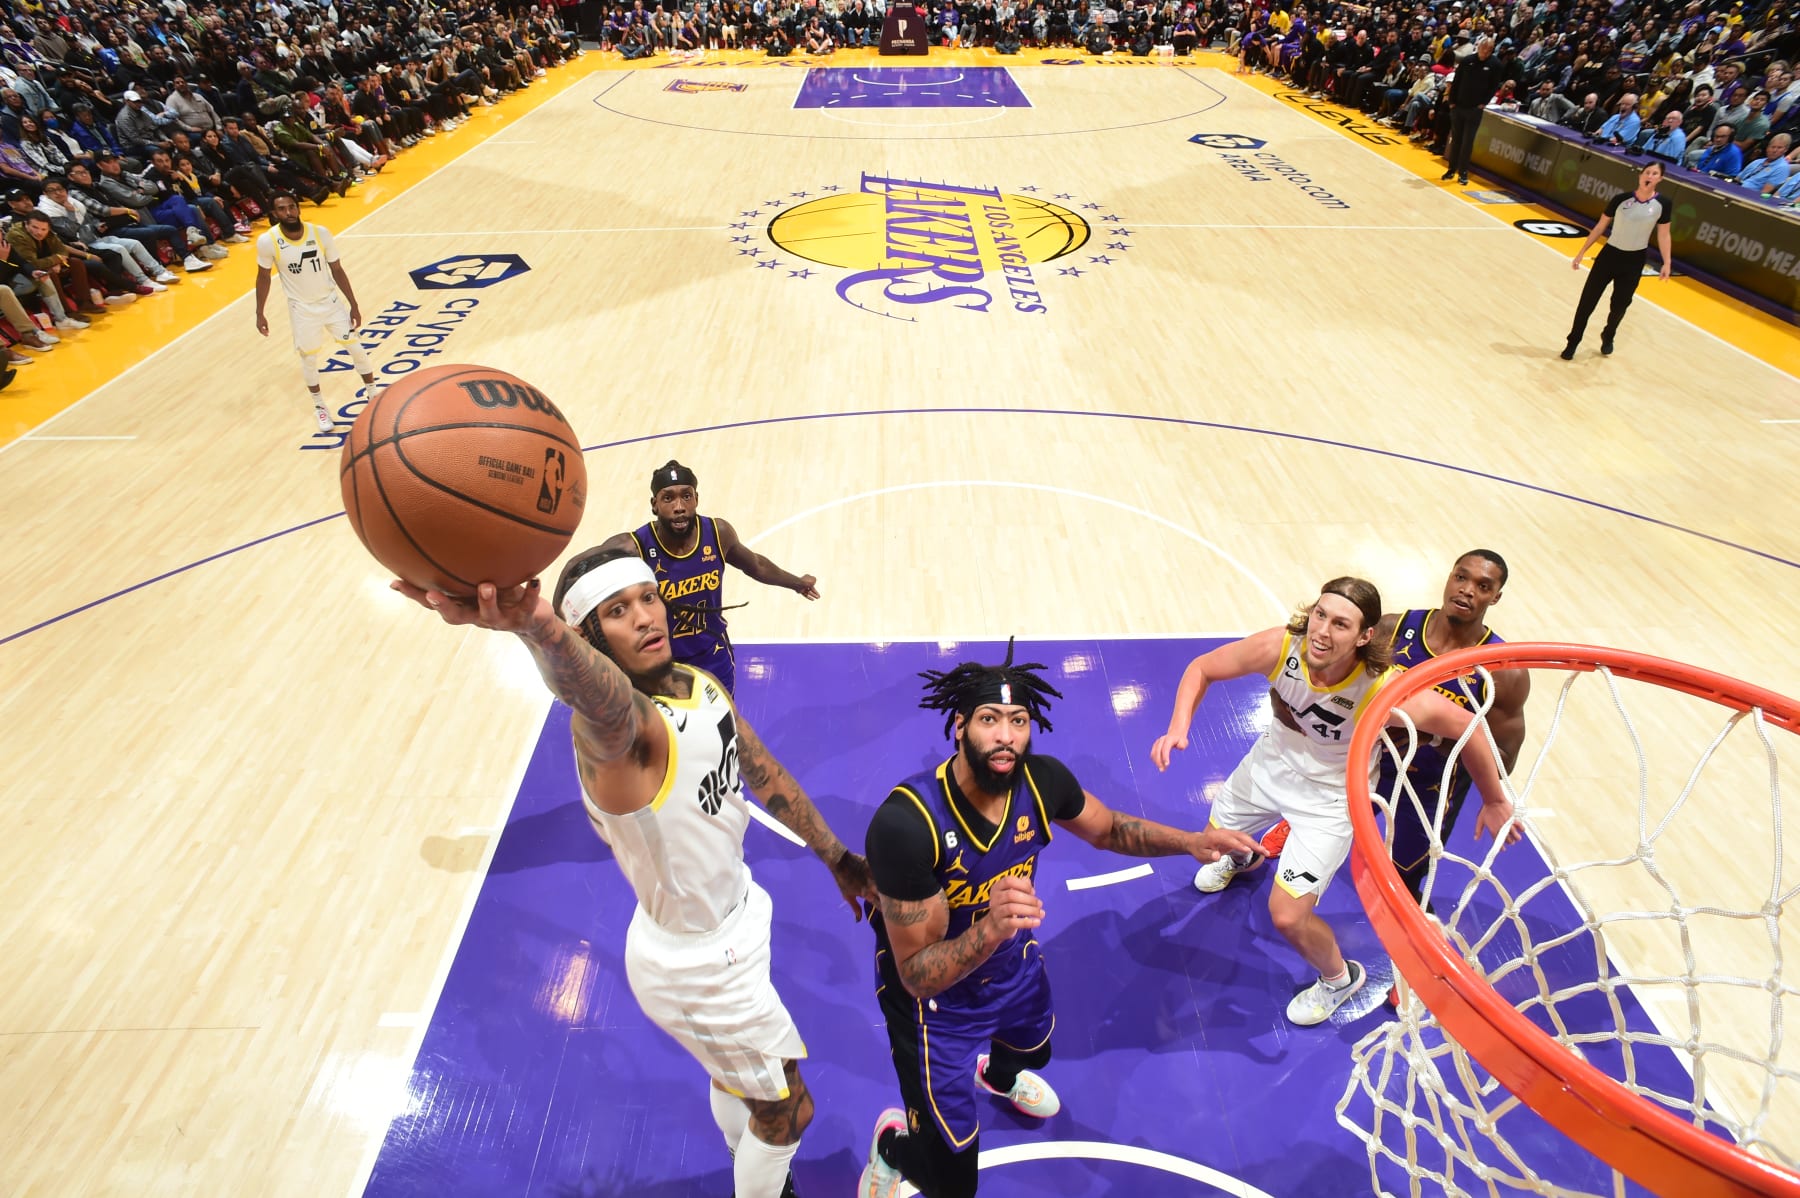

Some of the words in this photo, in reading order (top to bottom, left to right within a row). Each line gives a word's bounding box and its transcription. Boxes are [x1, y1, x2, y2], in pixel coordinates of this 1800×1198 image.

[1303, 104, 1403, 146] LEXUS
[1215, 152, 1272, 182] ARENA
[1488, 137, 1526, 164] BEYOND
[1523, 151, 1554, 176] MEAT
[1253, 152, 1351, 209] crypto.com
[982, 204, 1015, 230] LOS
[835, 170, 993, 323] LAKERS
[1695, 221, 1765, 263] BEYOND
[309, 257, 322, 273] 11
[991, 230, 1048, 315] ANGELES
[478, 455, 506, 471] OFFICIAL
[505, 461, 523, 476] GAME
[522, 466, 536, 479] BALL
[649, 547, 657, 558] 6
[658, 569, 720, 601] LAKERS
[672, 599, 707, 639] 21
[1404, 628, 1416, 640] 6
[1288, 658, 1298, 670] 6
[1311, 723, 1342, 741] 41
[944, 831, 958, 849] 6
[1014, 829, 1036, 845] bibigo
